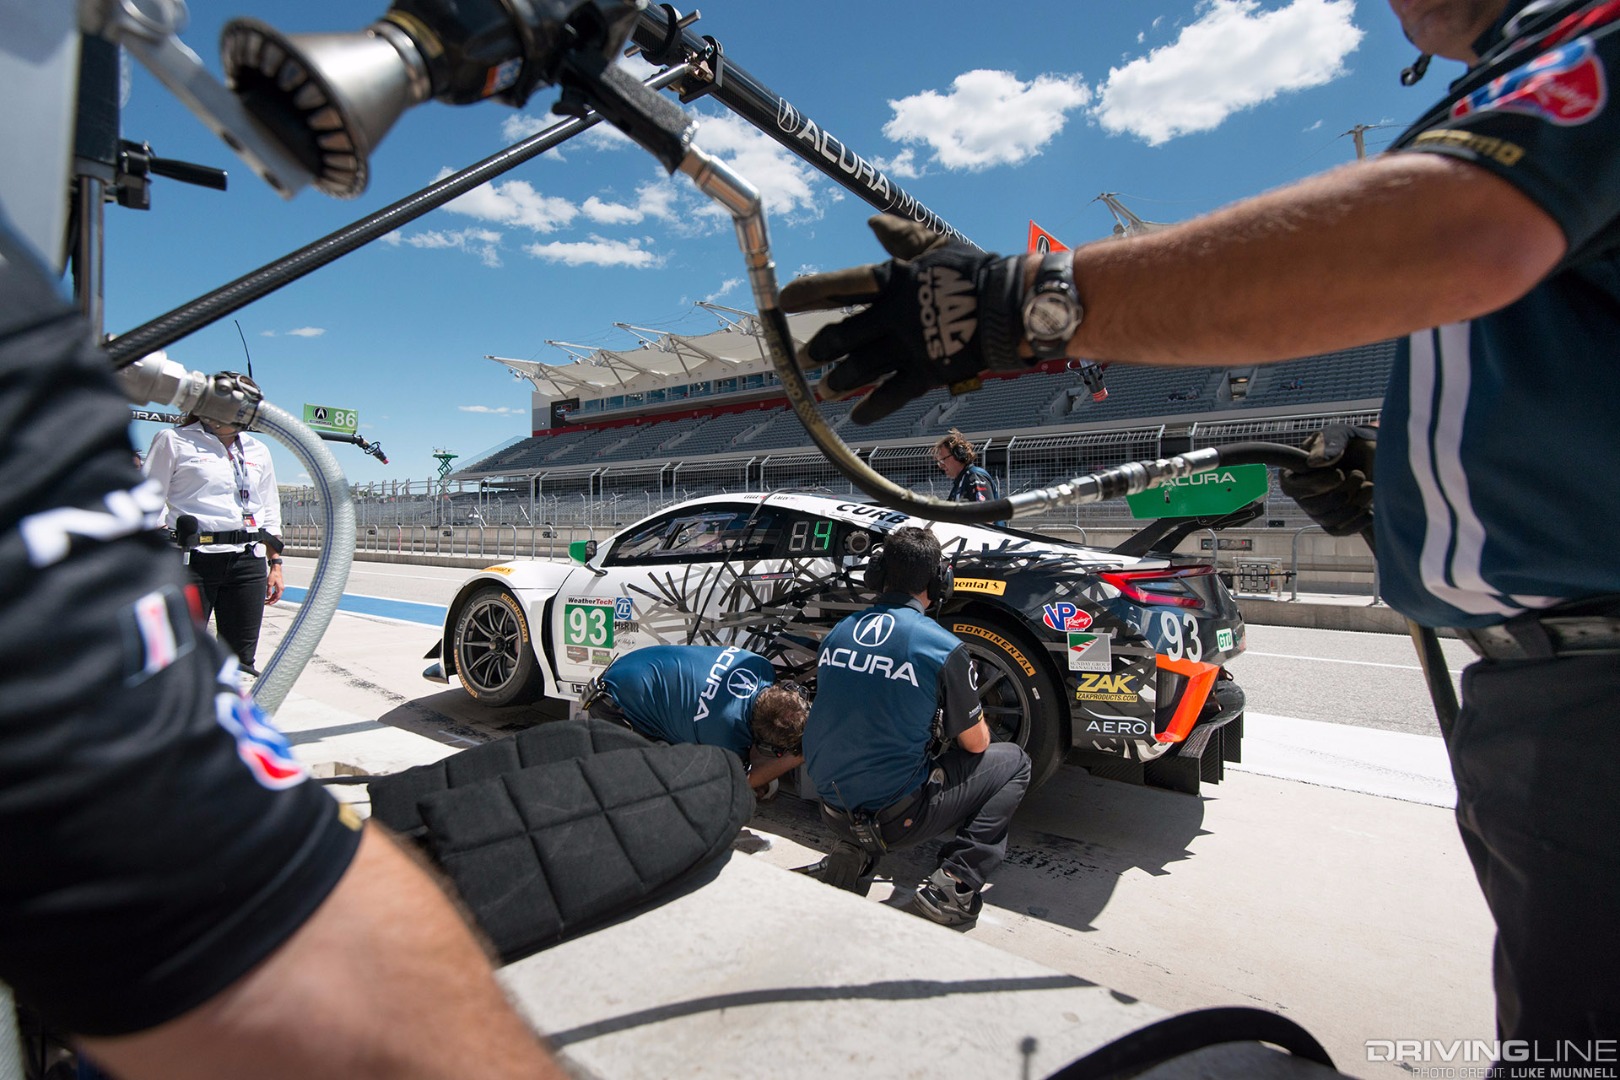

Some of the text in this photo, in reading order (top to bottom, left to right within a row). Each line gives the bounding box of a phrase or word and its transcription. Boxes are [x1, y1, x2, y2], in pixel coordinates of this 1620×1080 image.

[797, 118, 890, 200] ACURA
[917, 266, 945, 360] TOOLS
[933, 266, 978, 357] MAC
[334, 411, 356, 428] 86
[1160, 472, 1237, 488] ACURA
[836, 503, 911, 524] CURB
[568, 597, 613, 605] WeatherTech
[617, 602, 630, 615] ZF
[569, 607, 608, 646] 93
[1043, 602, 1077, 631] VP
[955, 624, 1032, 674] CONTINENTAL
[1160, 610, 1203, 664] 93
[818, 647, 919, 688] ACURA
[693, 646, 741, 722] ACURA
[1077, 673, 1136, 694] ZAK
[1077, 692, 1137, 702] ZAKPRODUCTS.COM
[1086, 720, 1147, 735] AERO
